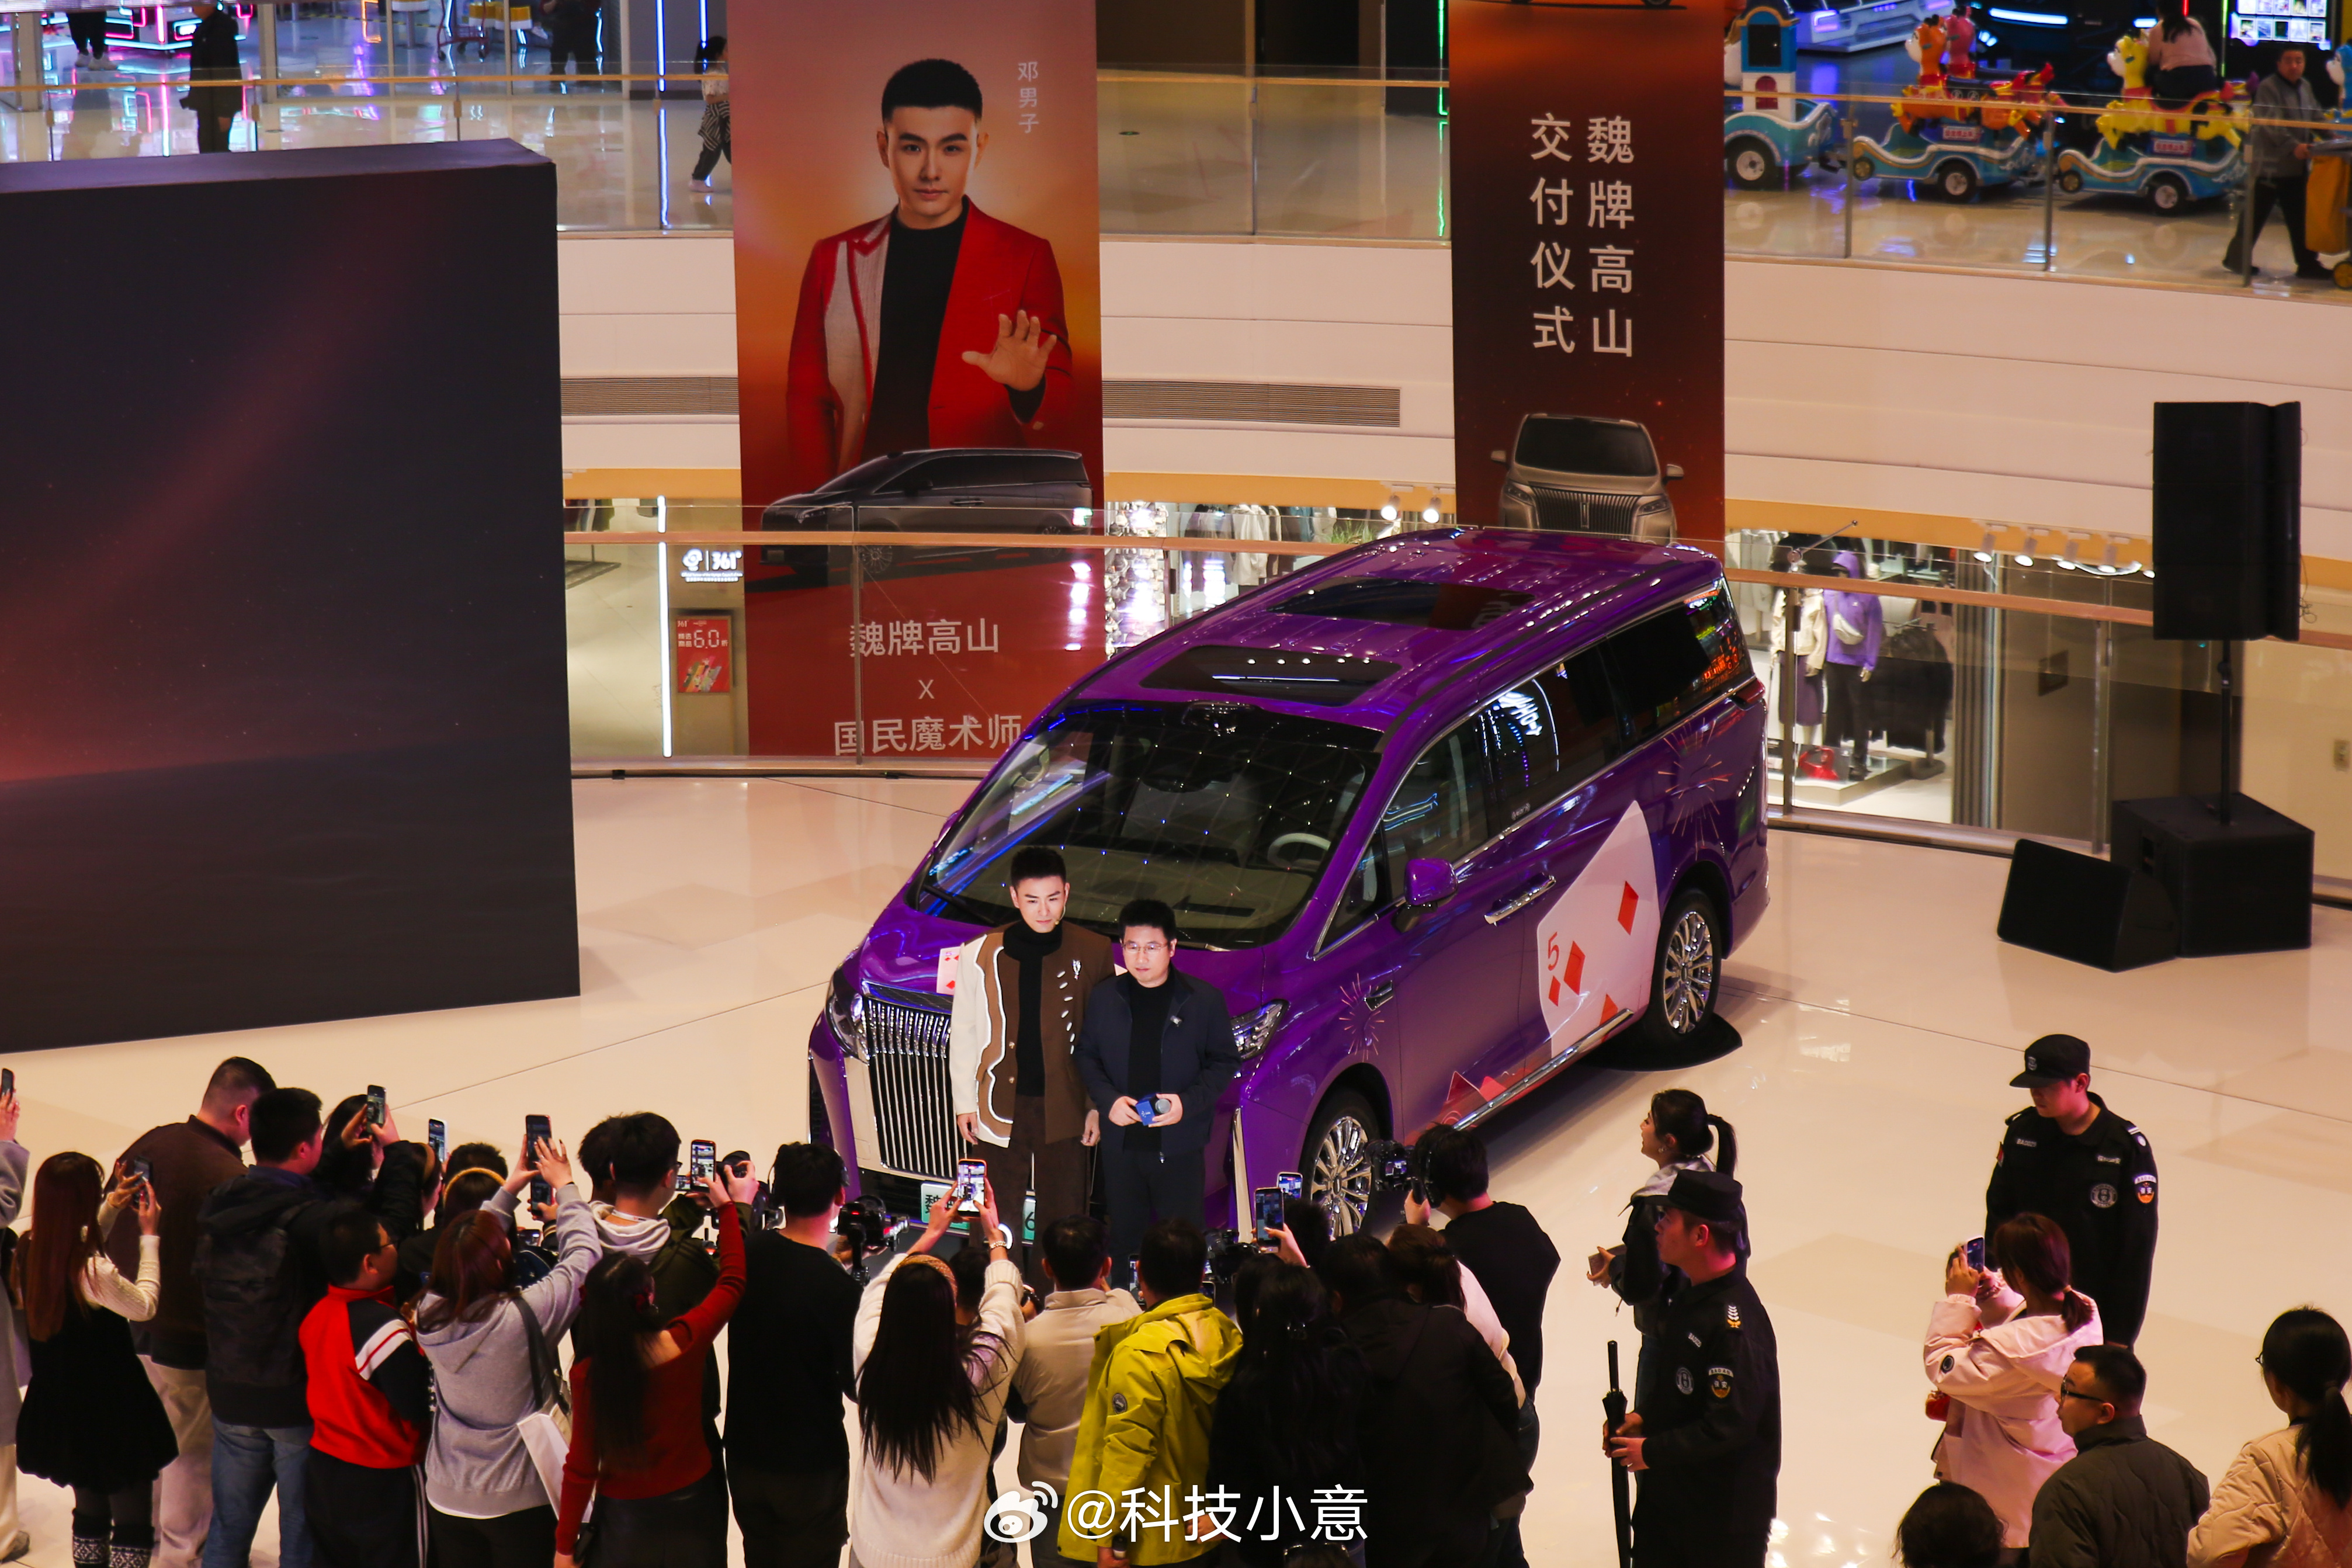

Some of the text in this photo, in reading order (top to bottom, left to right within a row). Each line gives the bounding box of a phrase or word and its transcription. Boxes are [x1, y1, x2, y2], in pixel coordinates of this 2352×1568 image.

[1018, 61, 1039, 133] 邓男子
[1529, 113, 1576, 353] 交付仪式
[1587, 116, 1635, 357] 魏牌高山
[849, 618, 999, 658] 魏牌高山
[834, 714, 1022, 756] 国民魔术师
[1548, 931, 1559, 971] 5
